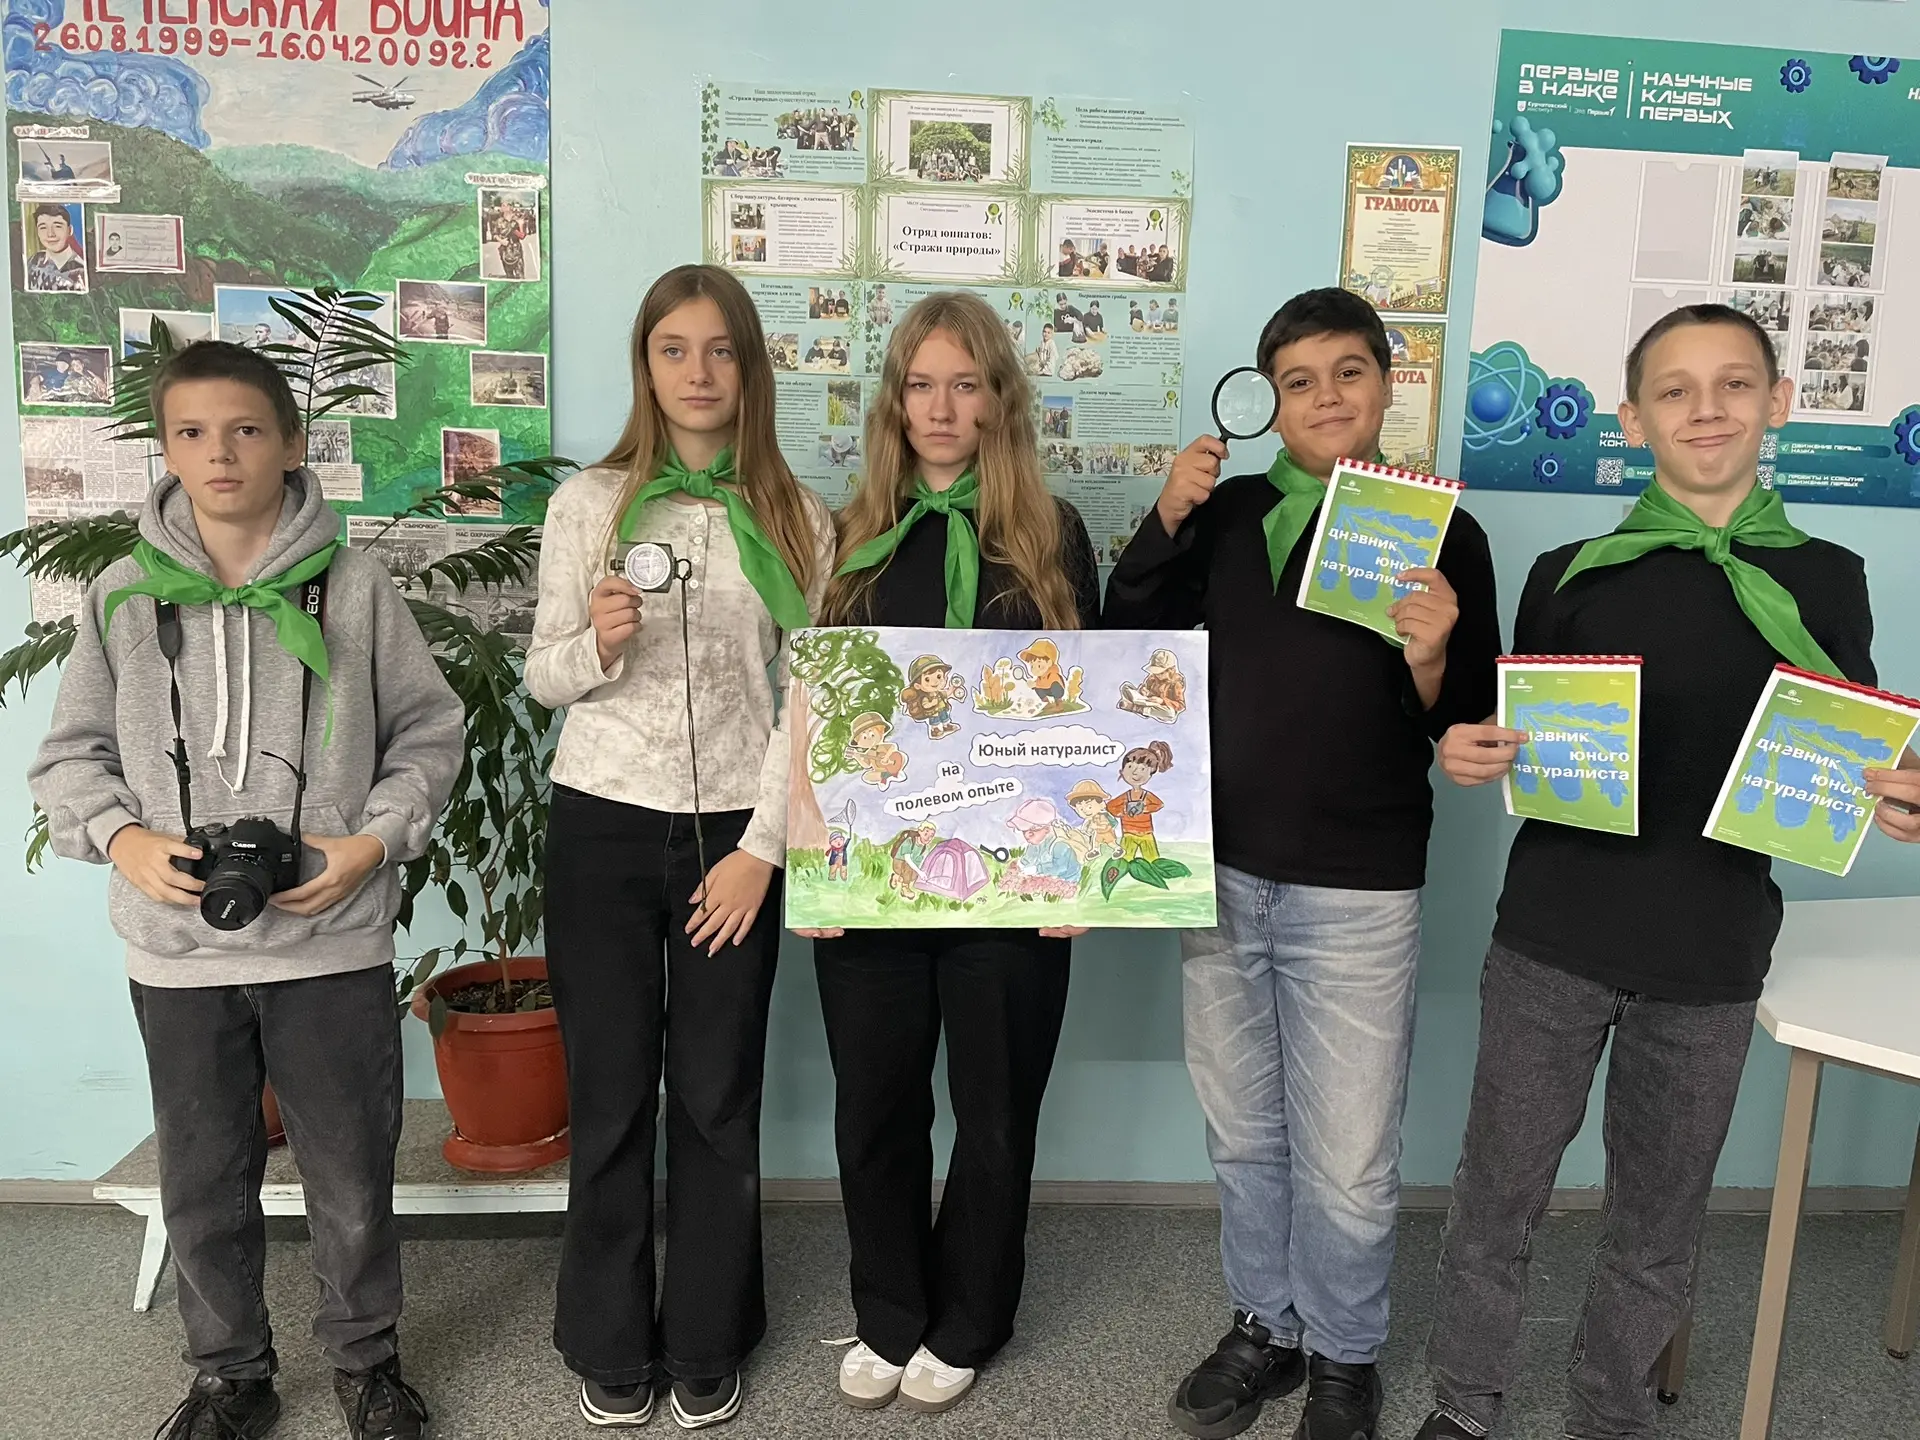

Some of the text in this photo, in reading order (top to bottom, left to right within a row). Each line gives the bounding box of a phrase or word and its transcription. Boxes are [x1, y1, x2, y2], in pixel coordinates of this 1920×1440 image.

[1519, 80, 1534, 94] В
[1643, 72, 1753, 92] НАУЧНЫЕ
[1641, 89, 1722, 107] КЛУБЫ
[1639, 106, 1734, 130] ПЕРВЫХ
[1364, 196, 1440, 213] ГРАМОТА
[902, 225, 992, 240] Отряд юннатов:
[893, 240, 1001, 256] «Стражи природы»
[306, 584, 320, 615] EOS
[1529, 731, 1590, 743] евник
[978, 742, 1116, 759] Юный натуралист
[1569, 750, 1630, 762] юного
[941, 764, 960, 777] на
[895, 780, 1015, 813] полевом опыте
[1741, 773, 1866, 818] натуралиста
[231, 841, 256, 849] Canon
[220, 899, 236, 920] Canon
